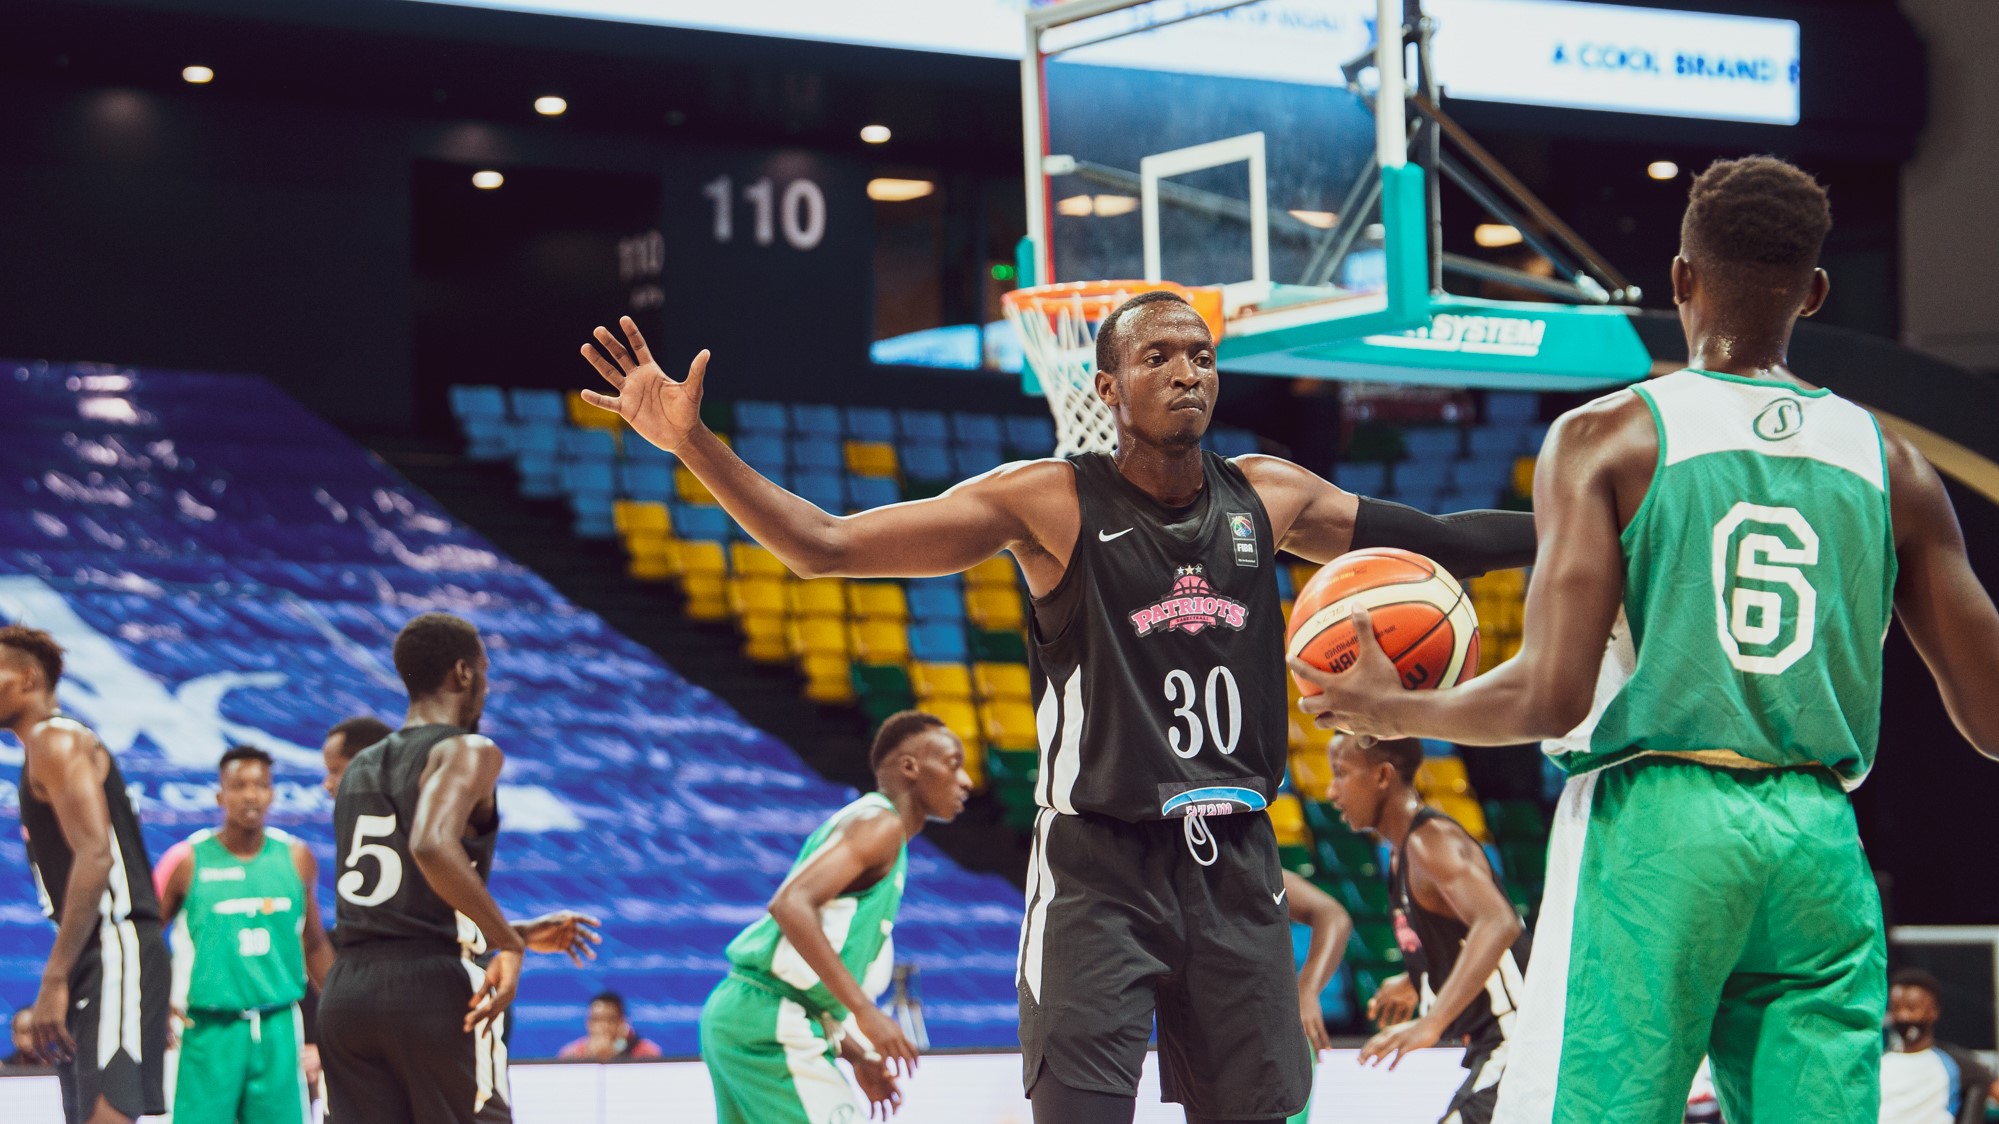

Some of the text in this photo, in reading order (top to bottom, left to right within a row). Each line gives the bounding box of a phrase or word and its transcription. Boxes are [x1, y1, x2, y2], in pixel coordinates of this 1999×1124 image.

[1552, 45, 1567, 63] A
[1580, 45, 1659, 73] COOL
[1674, 54, 1776, 82] BRAND
[704, 176, 826, 249] 110
[1430, 313, 1546, 346] SYSTEM
[1236, 543, 1254, 553] FIBA
[1712, 501, 1819, 675] 6
[1131, 596, 1246, 634] PATRIOTS
[1176, 615, 1209, 623] BASKETBALL
[1164, 665, 1242, 759] 30
[337, 813, 402, 907] 5
